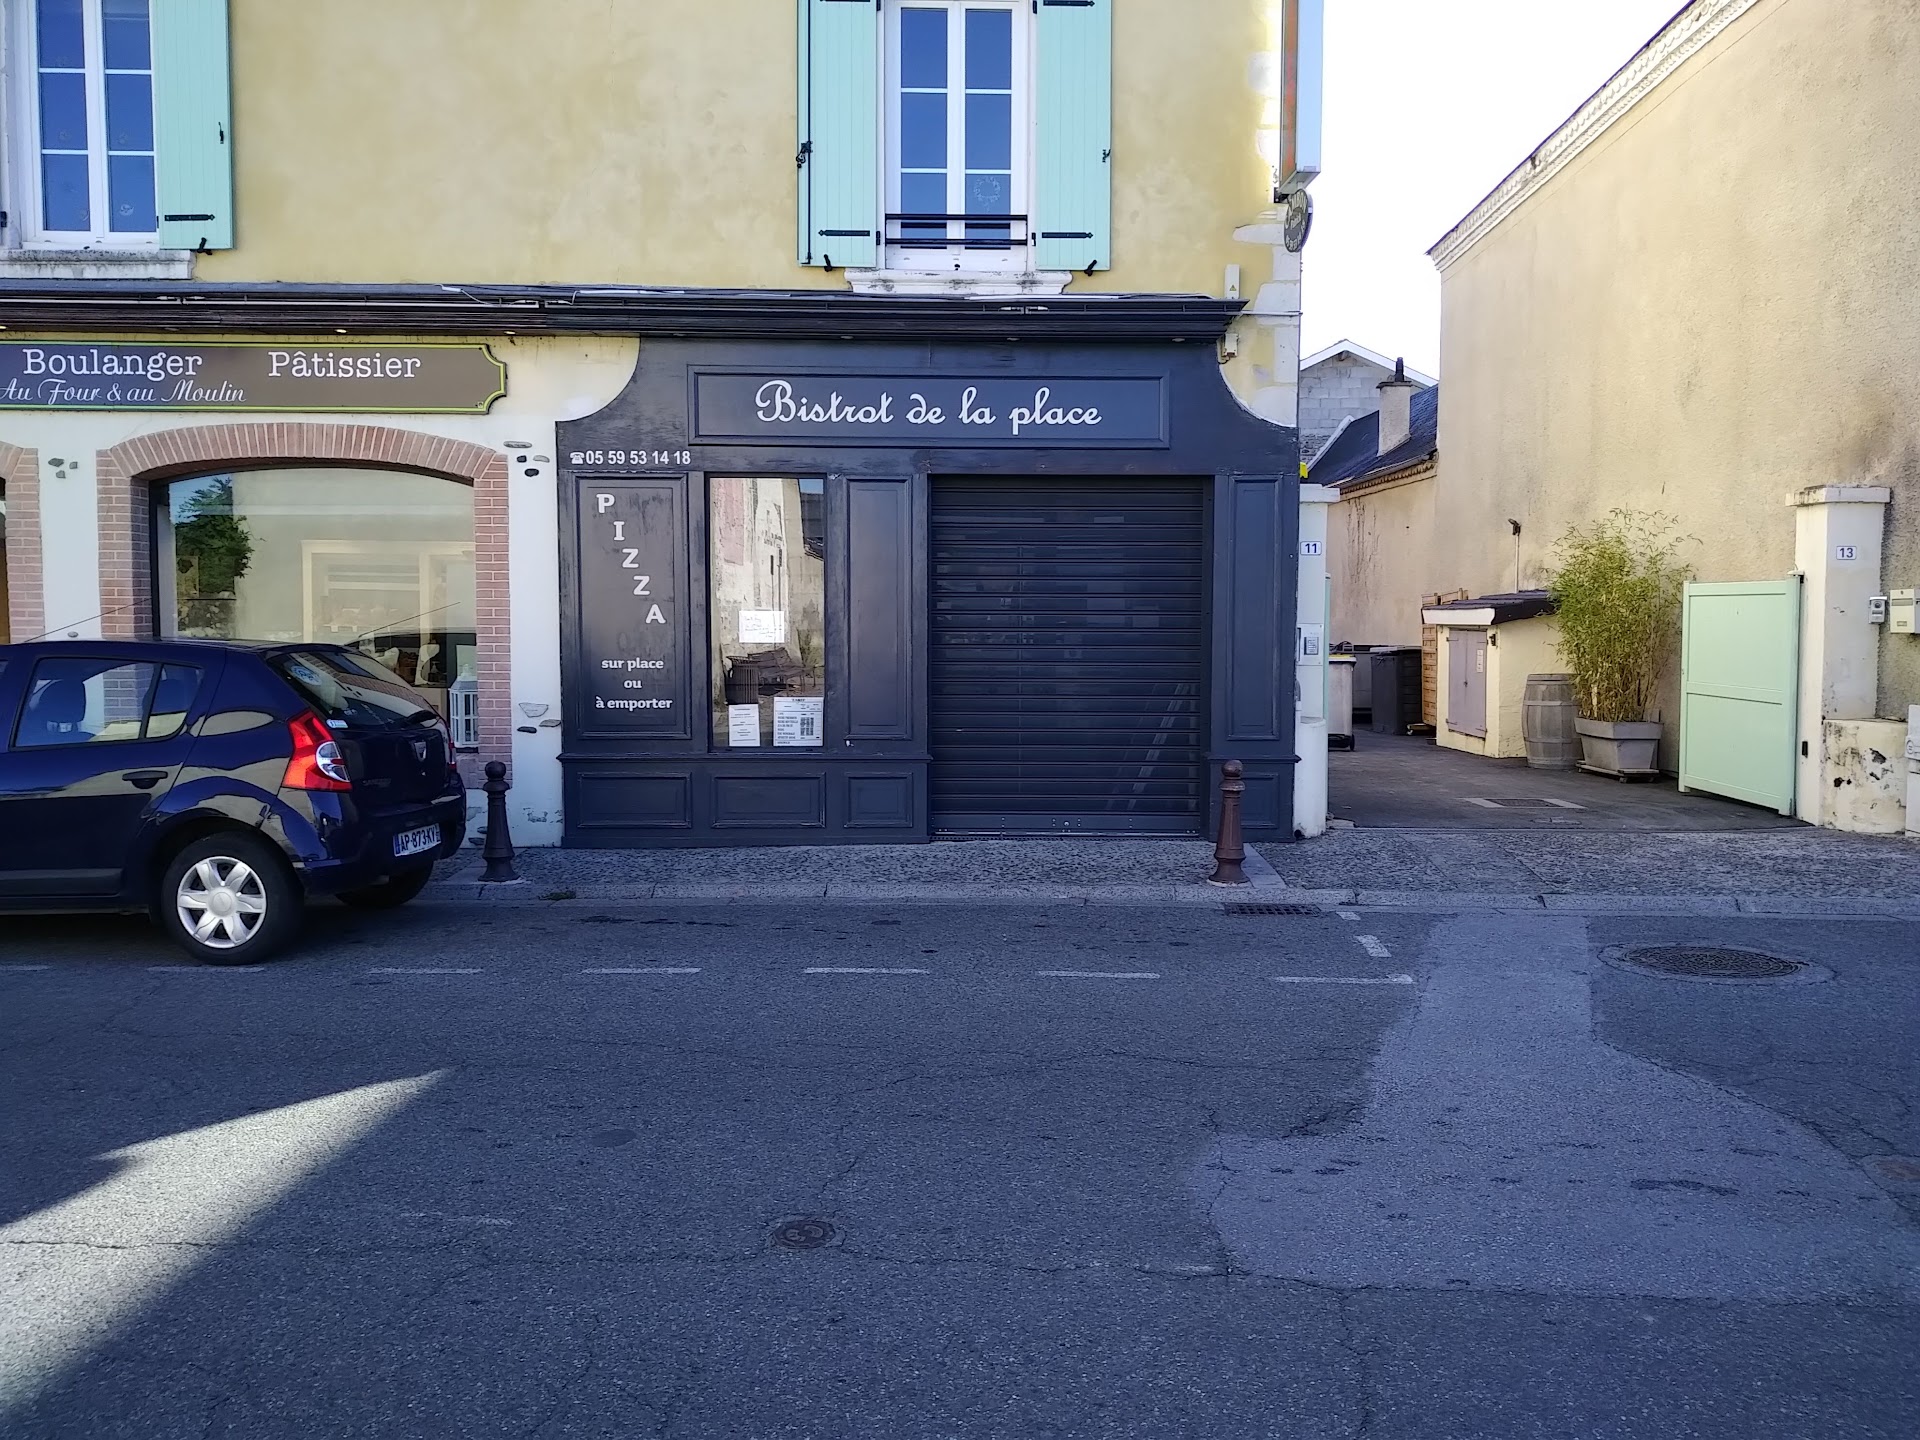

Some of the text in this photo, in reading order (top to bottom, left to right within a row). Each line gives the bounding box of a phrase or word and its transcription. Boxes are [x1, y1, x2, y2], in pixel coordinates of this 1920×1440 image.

[22, 348, 421, 382] Boulanger Pâtissier
[0, 377, 247, 405] Au Four & au Moulin
[755, 379, 1103, 435] Bistrot de la place
[585, 450, 691, 465] 05 59 53 14 18
[1304, 542, 1317, 554] 11
[1839, 547, 1854, 558] 13
[601, 657, 664, 672] sur place
[623, 679, 642, 689] ou
[595, 696, 673, 711] à emporter
